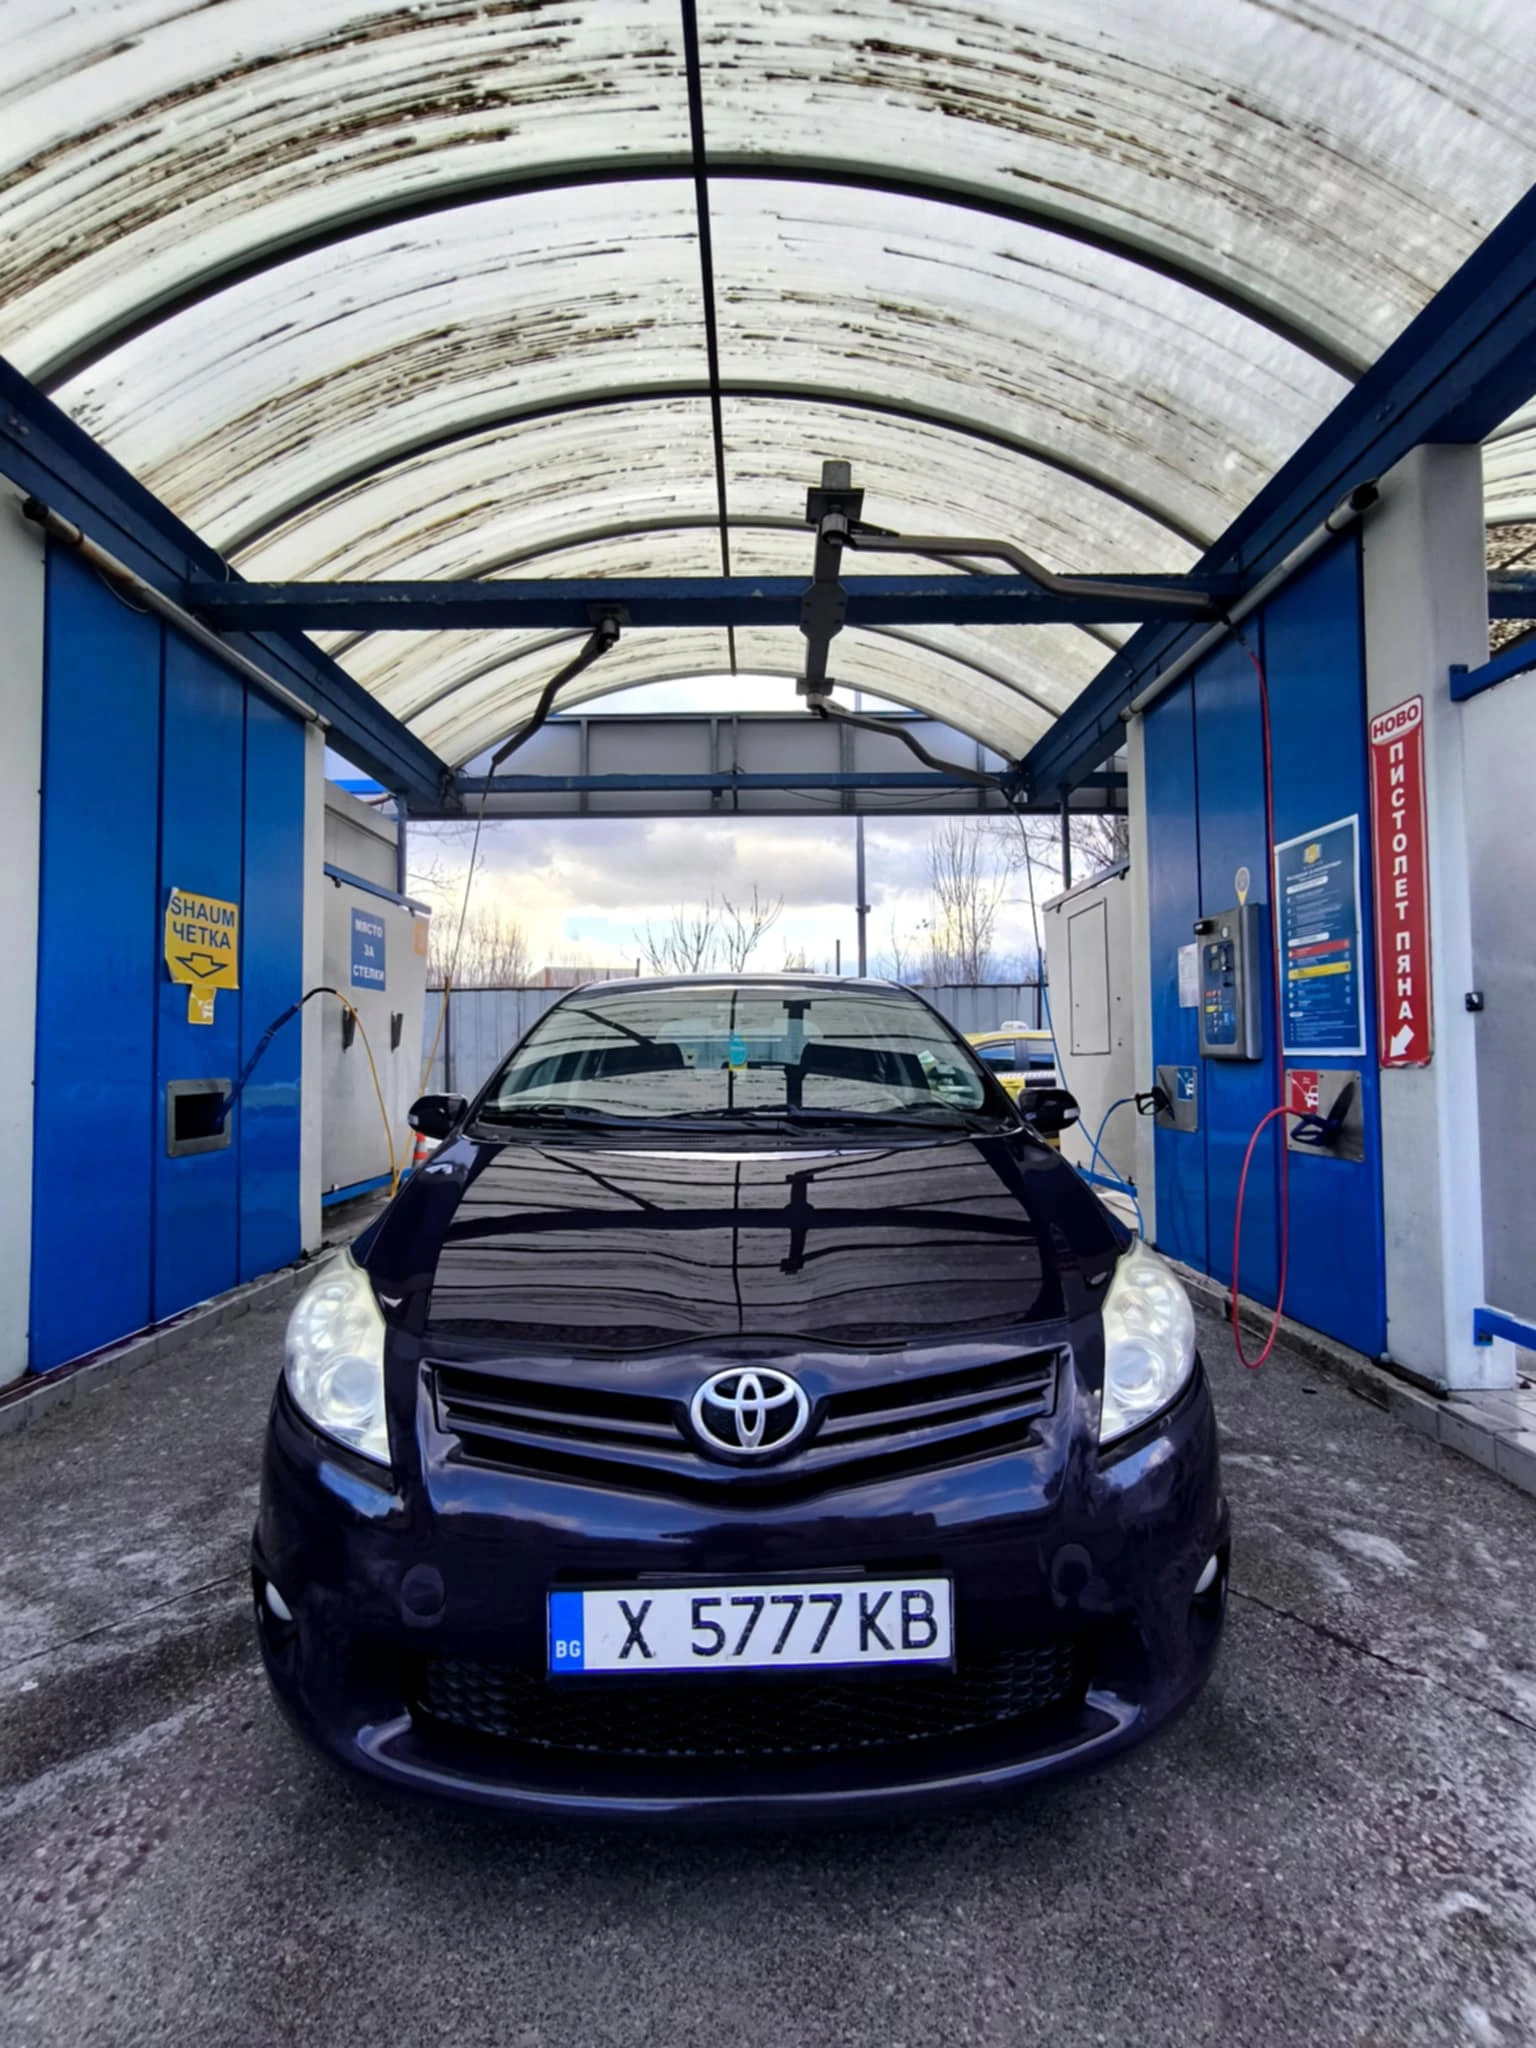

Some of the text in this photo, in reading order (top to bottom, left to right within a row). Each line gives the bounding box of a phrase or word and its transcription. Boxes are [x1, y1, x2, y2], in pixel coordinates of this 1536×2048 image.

[1373, 705, 1419, 739] НОВО
[1389, 741, 1414, 1020] ПИСТОЛЕТ ПЯНА
[170, 895, 235, 928] SHAUM
[172, 920, 231, 950] ЧЕТКА
[555, 1639, 582, 1659] BG
[617, 1599, 653, 1659] X
